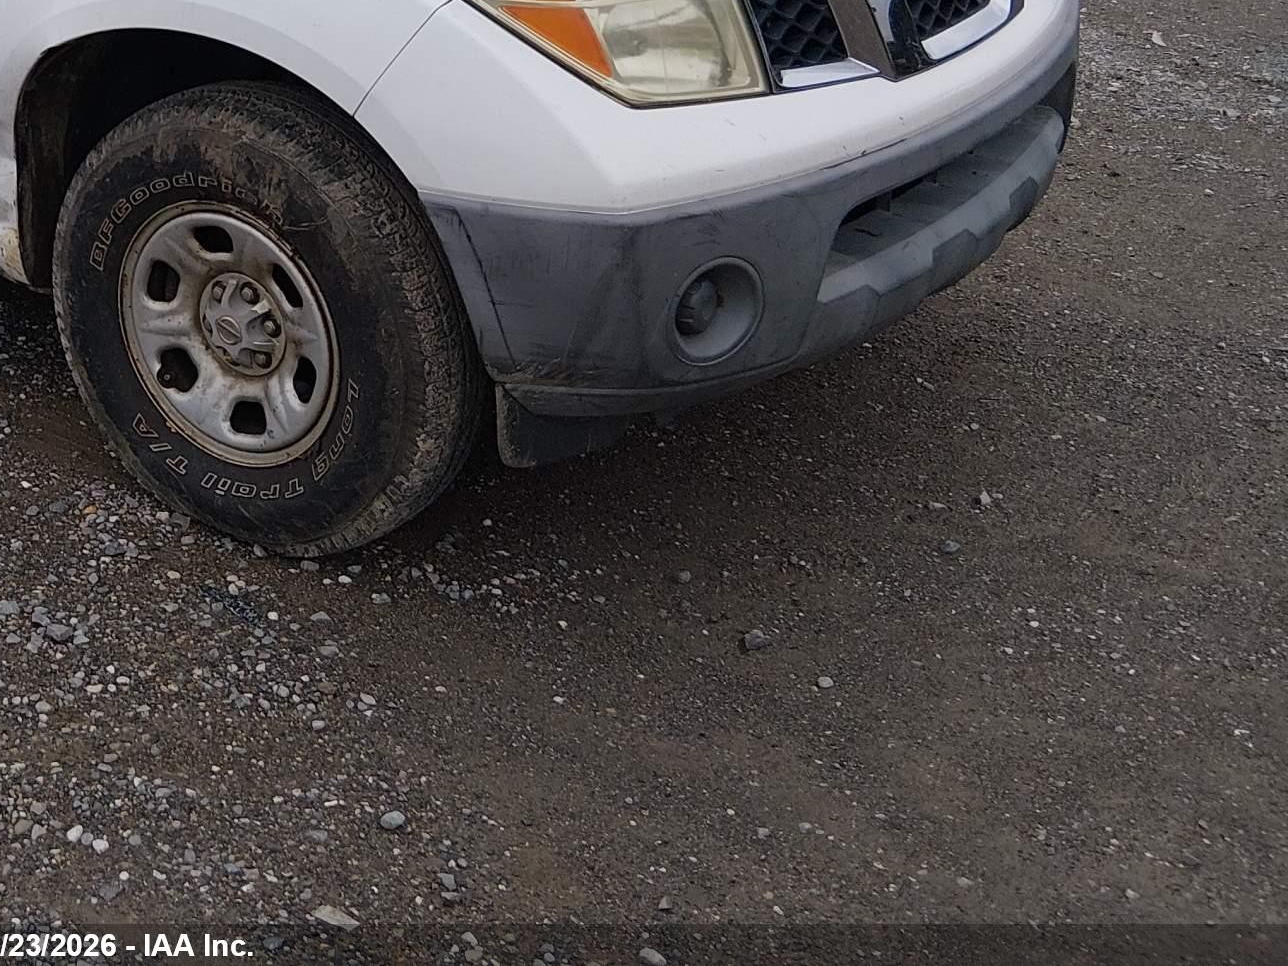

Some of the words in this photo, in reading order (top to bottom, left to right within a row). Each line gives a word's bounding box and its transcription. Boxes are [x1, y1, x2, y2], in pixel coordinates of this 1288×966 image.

[88, 171, 283, 272] BFGoodrich
[131, 412, 190, 475] T/A
[312, 378, 360, 481] Long
[200, 472, 305, 500] Trail
